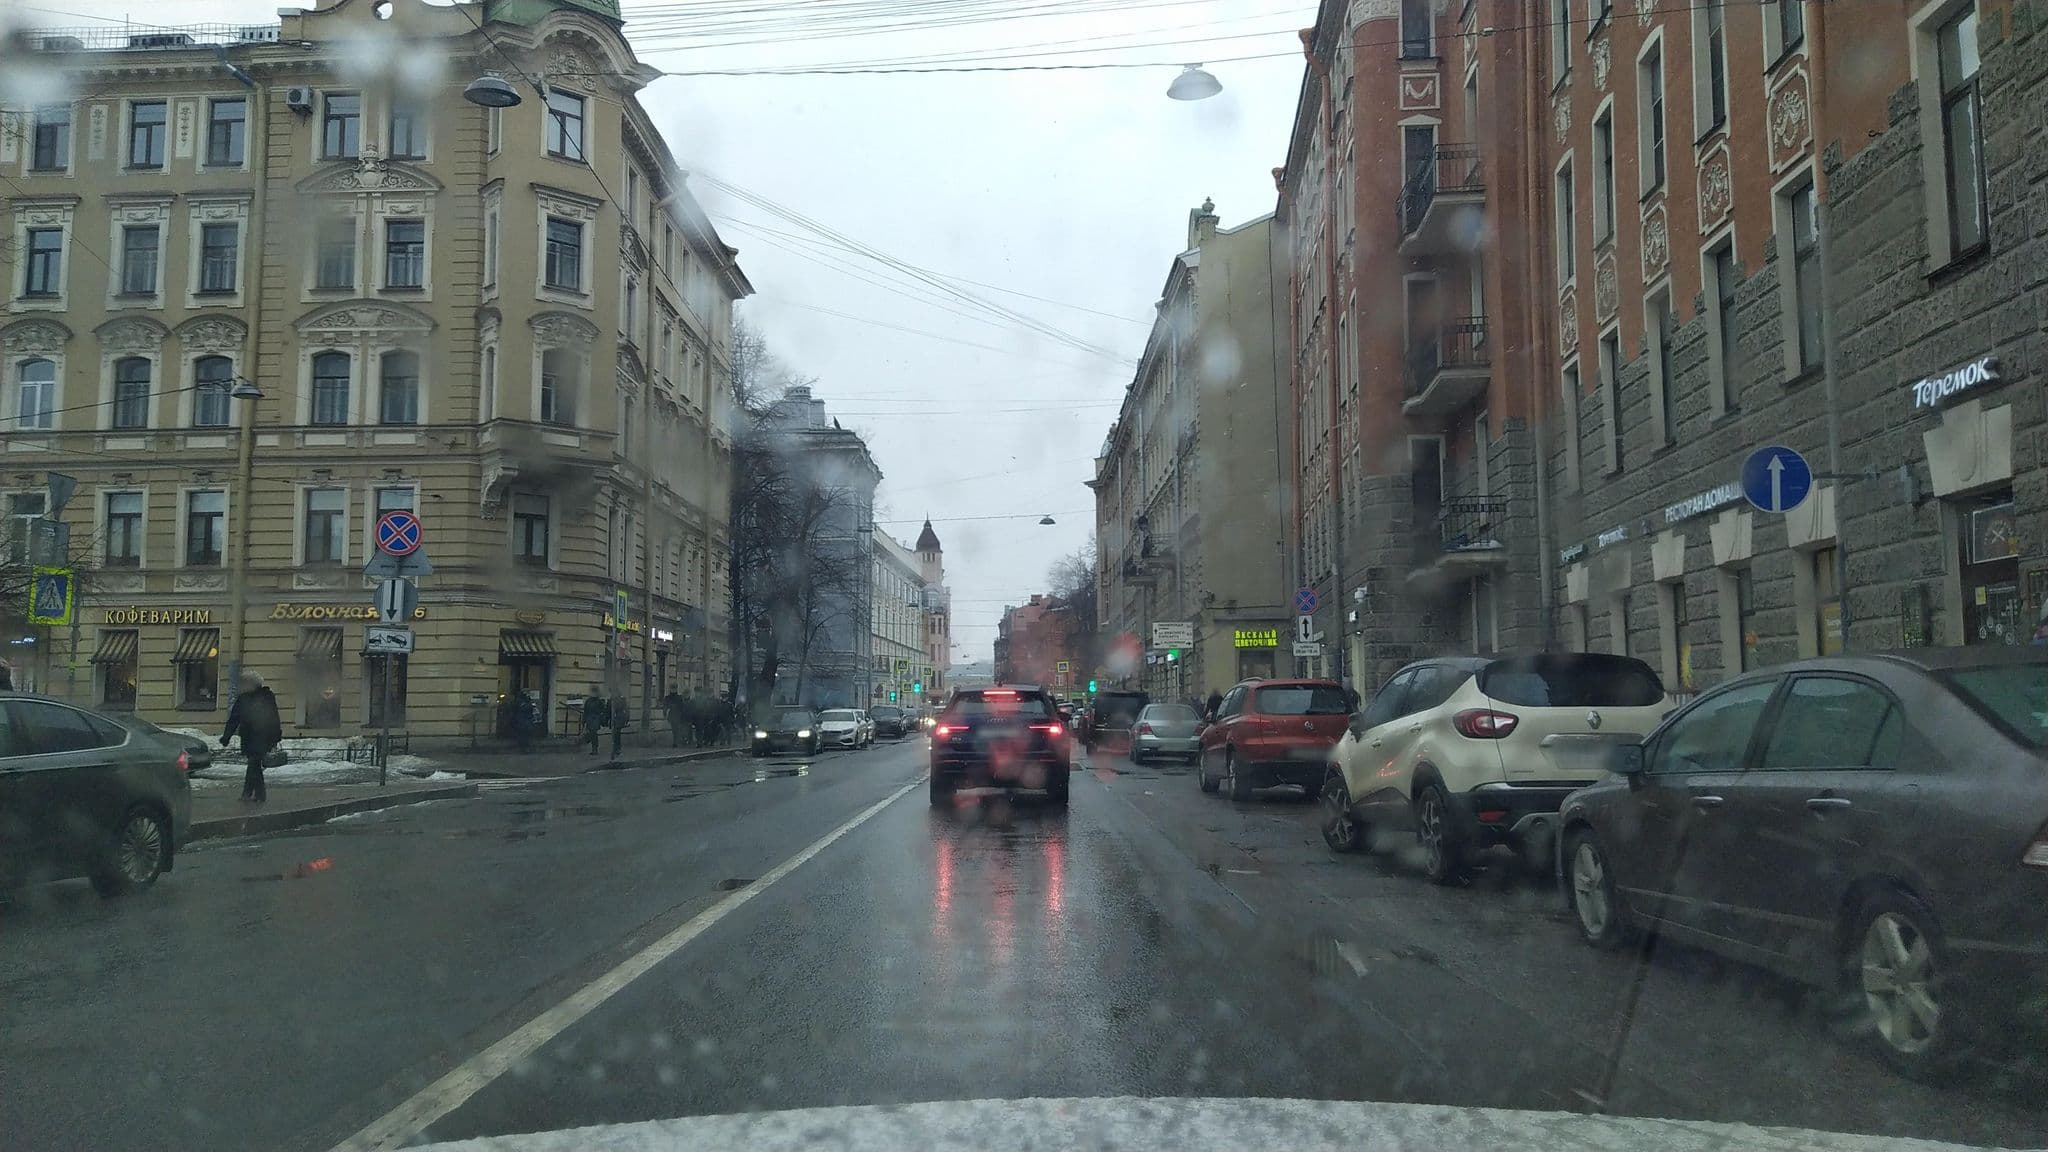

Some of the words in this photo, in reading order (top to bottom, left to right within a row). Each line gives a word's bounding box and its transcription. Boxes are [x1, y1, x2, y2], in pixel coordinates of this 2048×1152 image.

[1912, 357, 1991, 408] Теремок
[1665, 494, 1703, 523] РЕСТОРАН
[1704, 481, 1743, 511] ДОМАШ
[105, 609, 209, 624] КОФЕВАРИМ
[269, 603, 380, 619] Булочная
